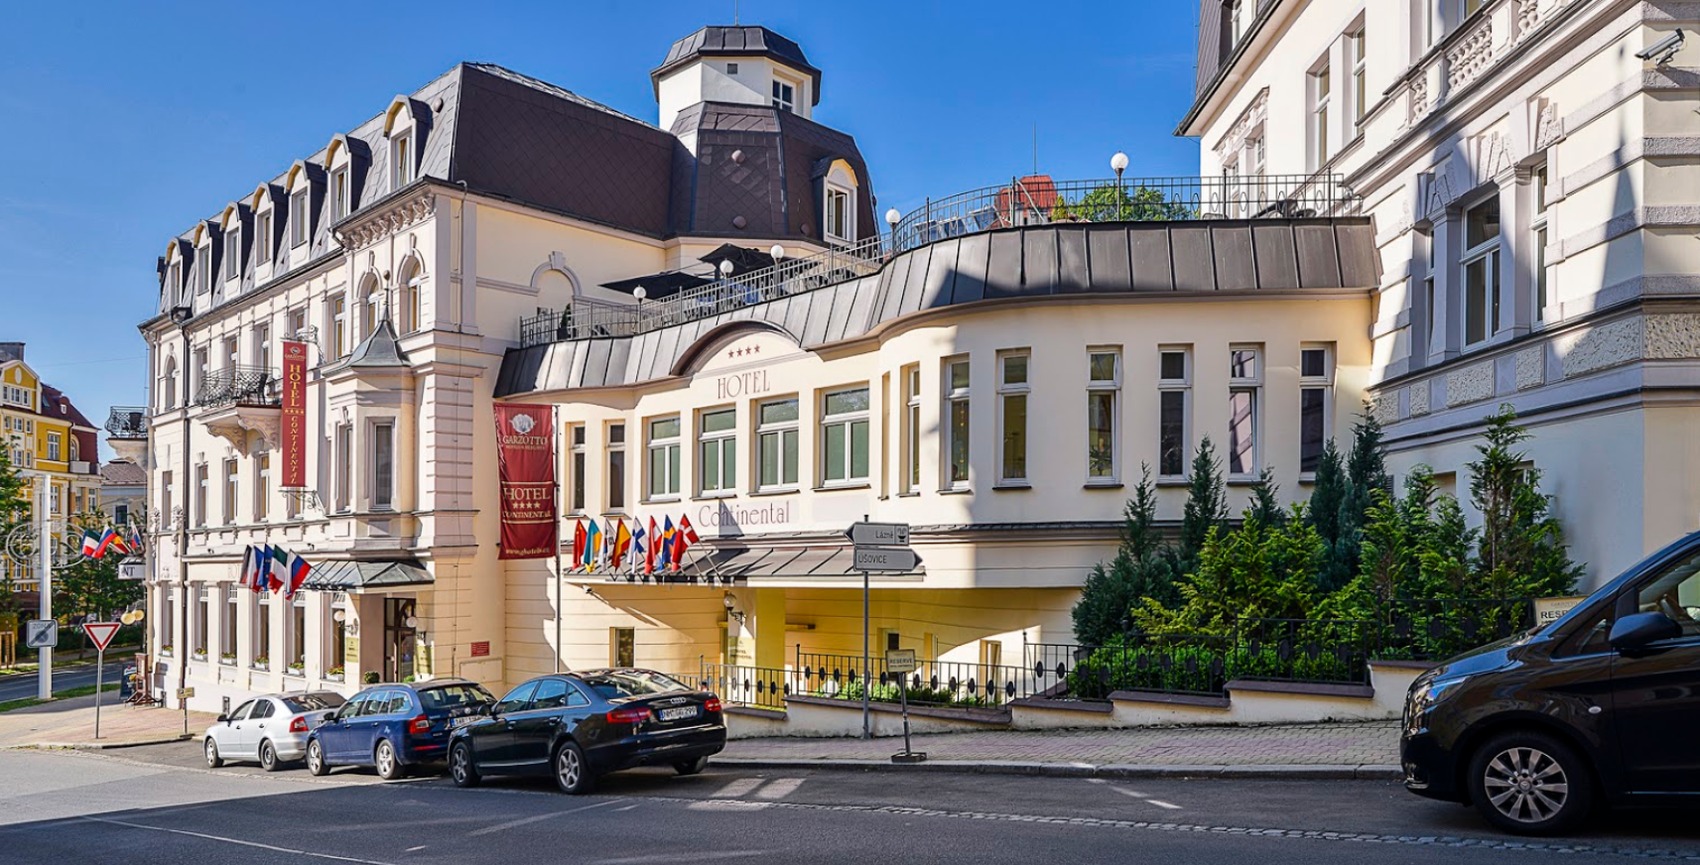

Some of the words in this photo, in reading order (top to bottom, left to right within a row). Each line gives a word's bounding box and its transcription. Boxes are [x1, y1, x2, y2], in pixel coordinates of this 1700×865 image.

[289, 363, 301, 407] HOTEL
[717, 370, 771, 400] HOTEL
[290, 416, 299, 484] CONTINENTAL
[502, 434, 548, 446] GARZOTTO
[503, 487, 551, 501] HOTEL
[502, 510, 553, 519] CONTINENTAL
[698, 501, 790, 527] Continental
